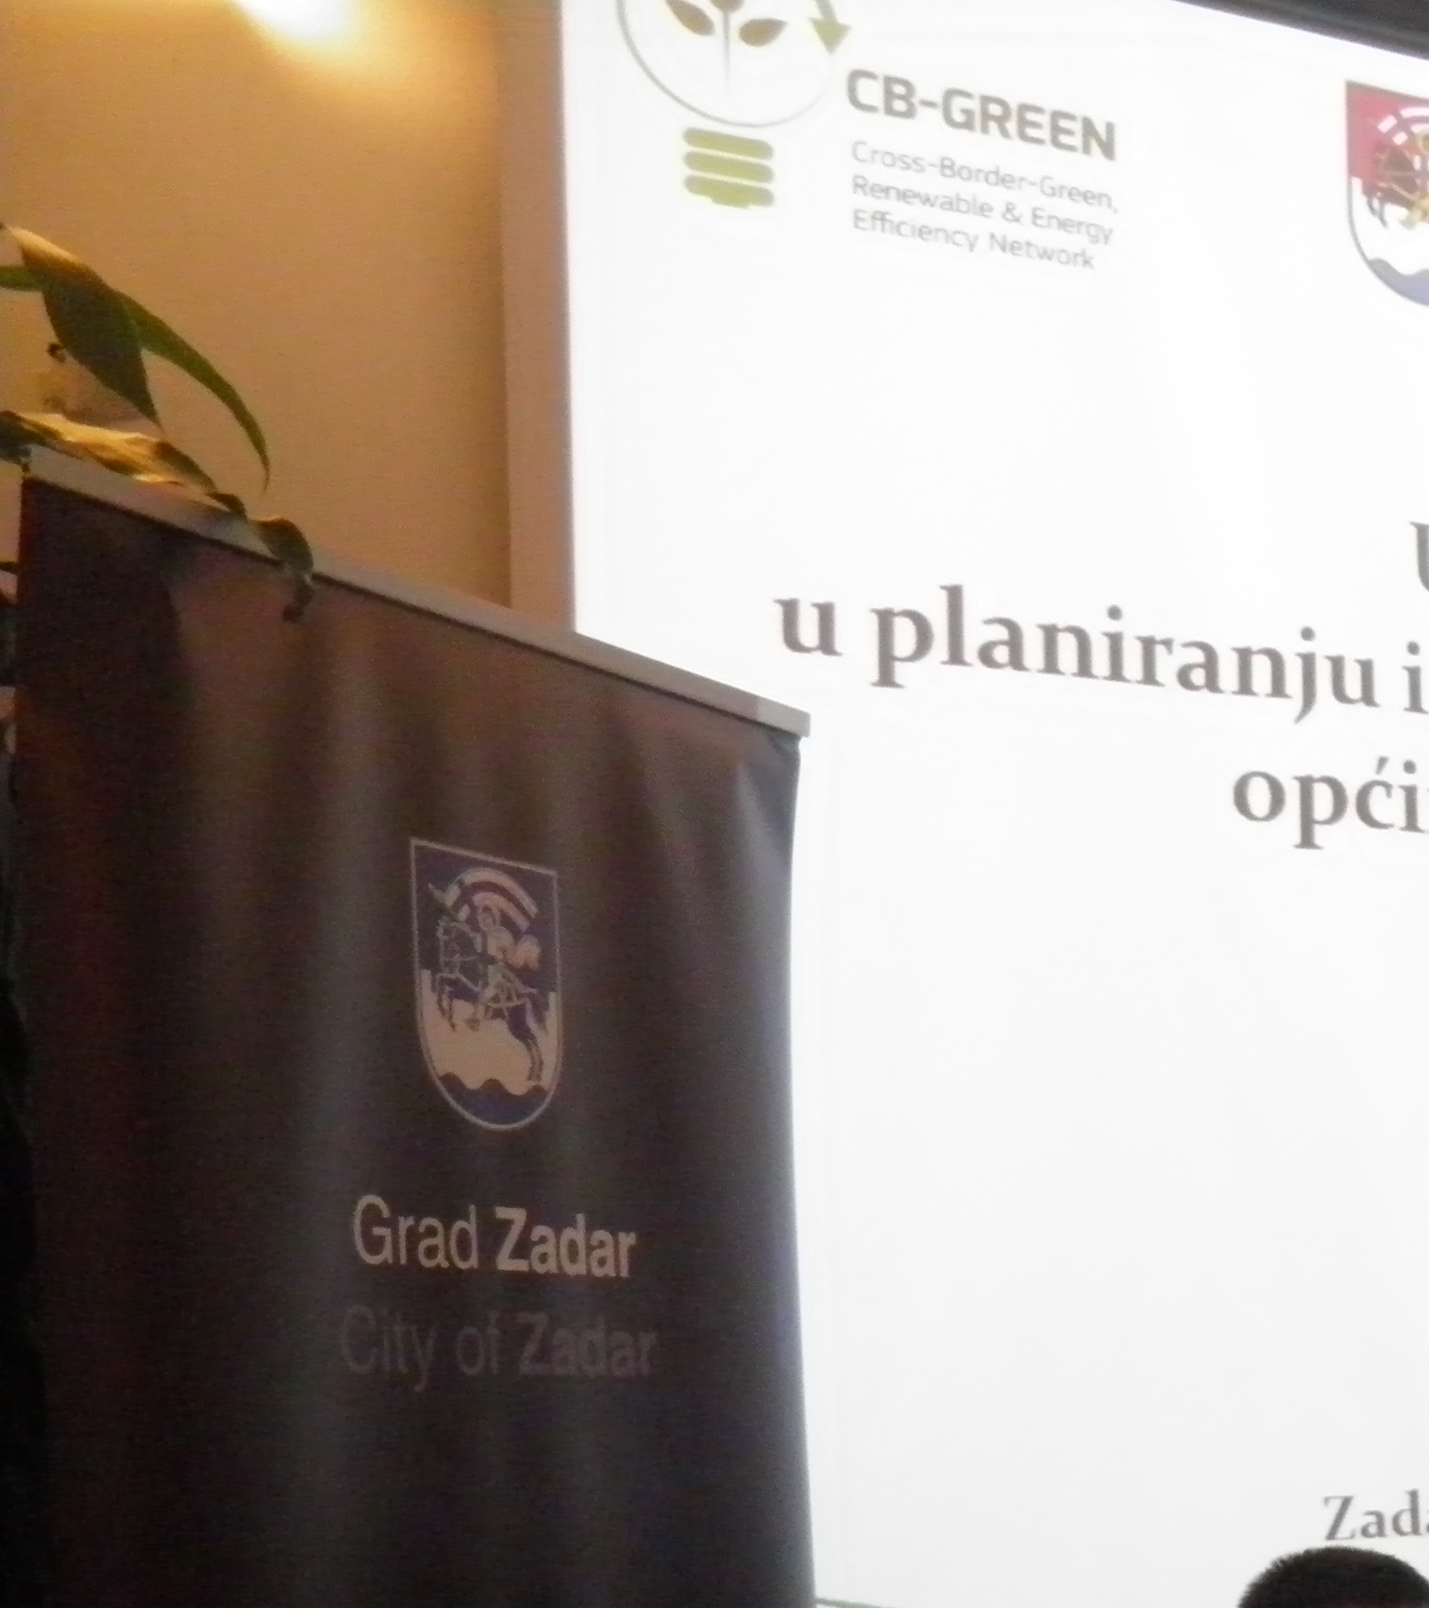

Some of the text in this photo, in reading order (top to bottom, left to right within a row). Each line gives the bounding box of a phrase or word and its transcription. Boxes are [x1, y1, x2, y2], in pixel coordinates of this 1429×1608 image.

[846, 69, 1116, 160] CB-GREEN
[852, 140, 1118, 213] Cross-Border-Green,
[852, 174, 1114, 246] Renewable & Energy
[853, 208, 1095, 269] Efficiency Network
[773, 598, 842, 657] u
[870, 584, 1380, 725] planiranju
[1402, 641, 1429, 714] i
[353, 1194, 638, 1278] Grad Zadar
[339, 1305, 660, 1392] City of Zadar
